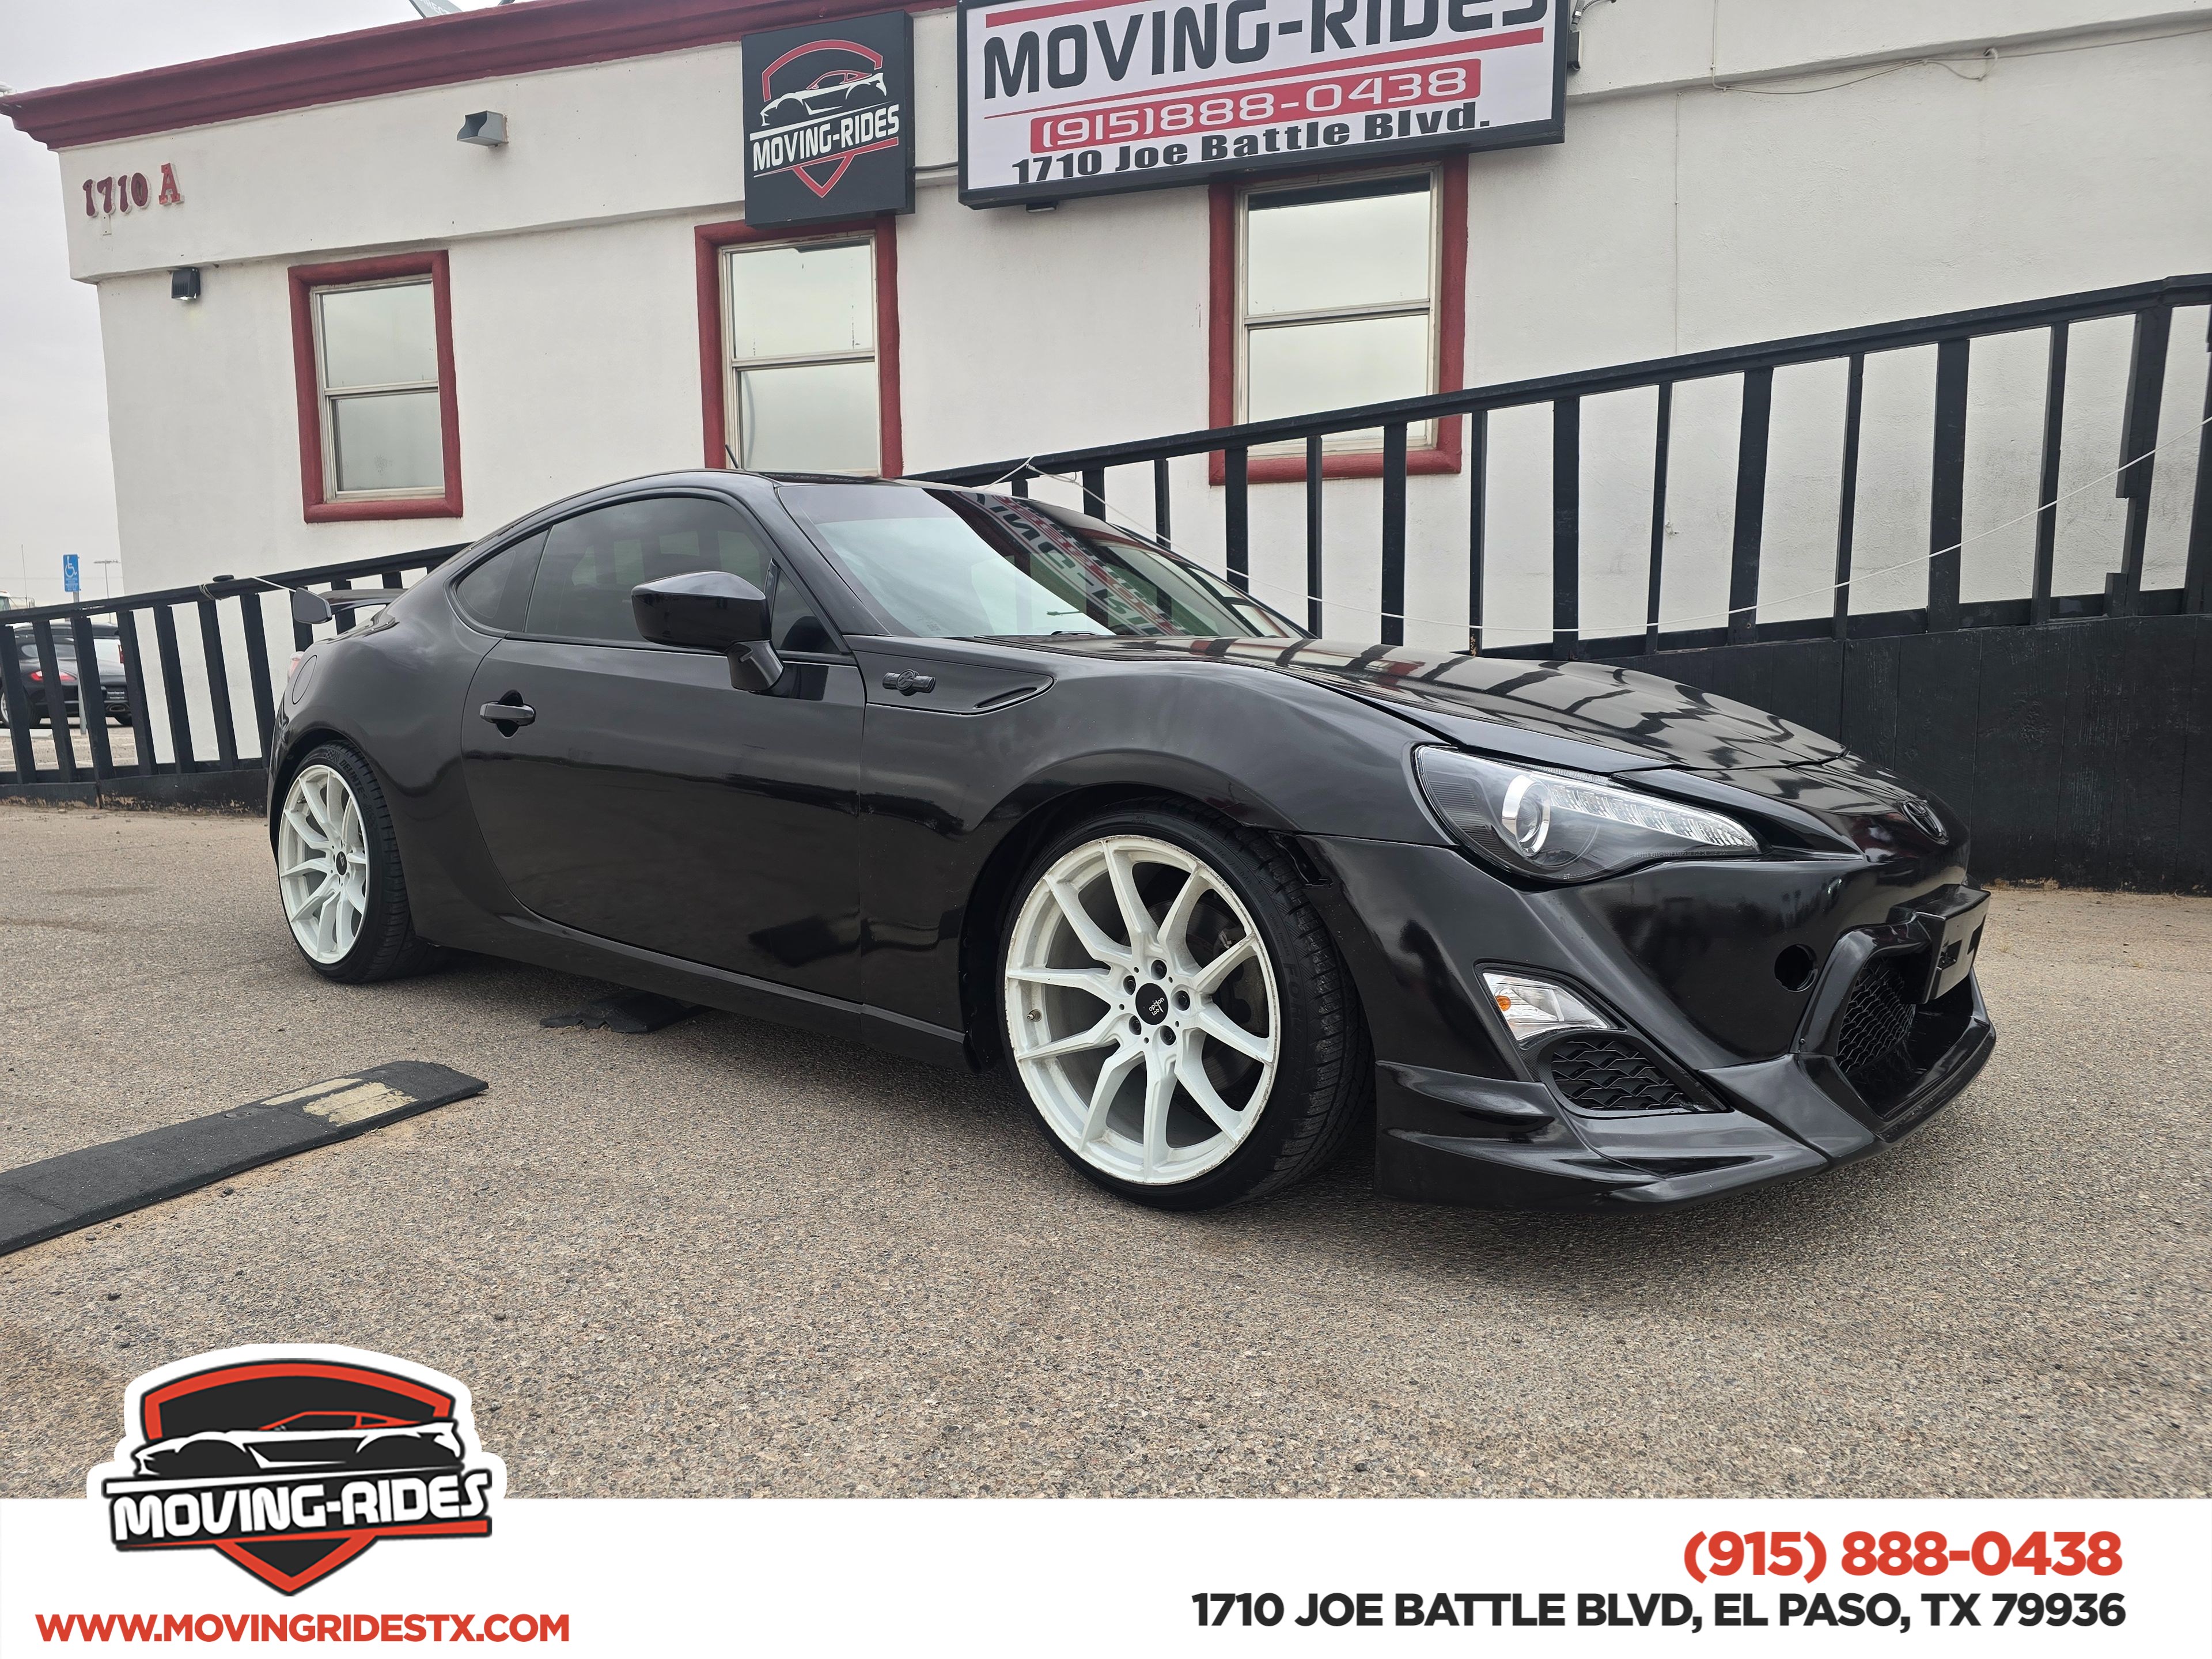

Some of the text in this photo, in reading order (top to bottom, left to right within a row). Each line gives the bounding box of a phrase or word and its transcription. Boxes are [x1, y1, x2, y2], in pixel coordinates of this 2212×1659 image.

[753, 104, 899, 172] MOVING-RIDES
[1012, 102, 1490, 184] 1710 Joe Battle Blvd.
[1043, 67, 1467, 147] (915)888-0438
[82, 162, 183, 217] 1710 A
